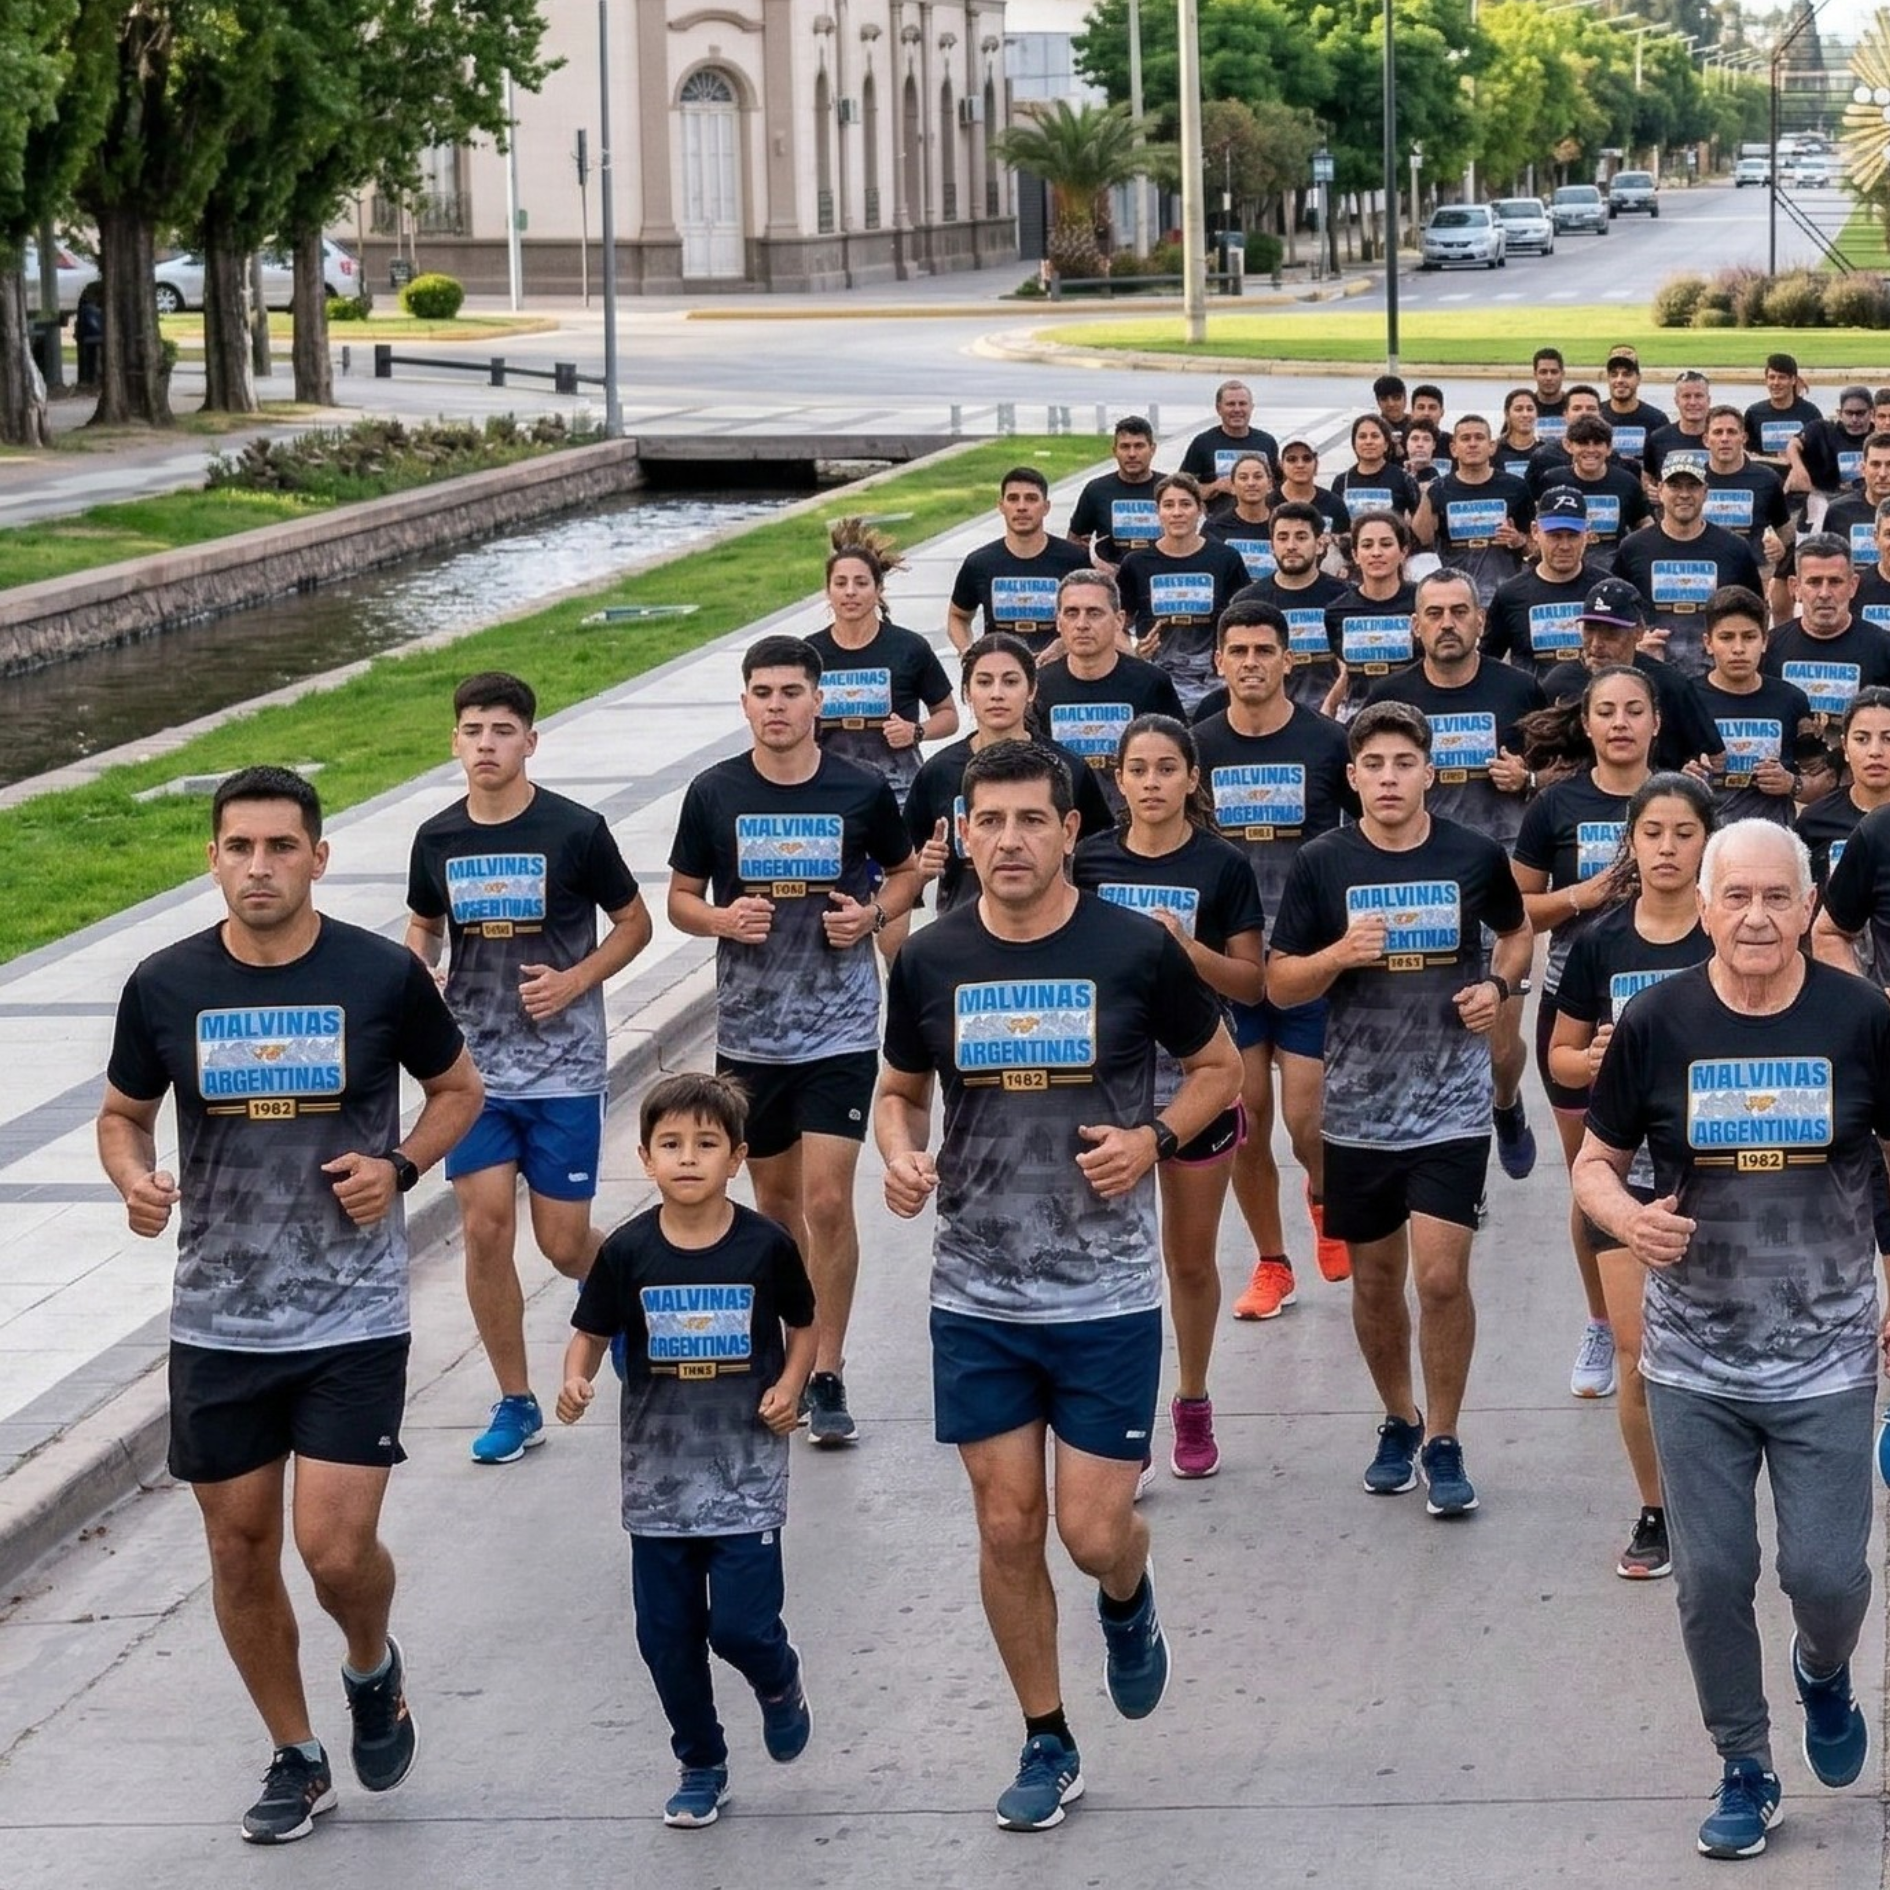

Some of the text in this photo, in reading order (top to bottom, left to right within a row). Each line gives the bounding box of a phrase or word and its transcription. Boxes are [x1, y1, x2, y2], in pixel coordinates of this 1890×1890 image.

[1214, 767, 1302, 786] MALVINAS
[739, 818, 841, 837] MALVINAS
[1349, 883, 1457, 909] MALVINAS
[1386, 928, 1457, 950] ENTINAS
[959, 984, 1091, 1012] MALVINAS
[202, 1009, 340, 1039] MALVINAS
[960, 1039, 1091, 1065] ARGENTINAS
[204, 1066, 341, 1093] ARGENTINAS
[1692, 1062, 1827, 1089] MALVINAS
[253, 1103, 291, 1115] 1982
[1694, 1119, 1827, 1143] ARGENTINAS
[1742, 1154, 1780, 1167] 1982
[643, 1289, 752, 1312] MALVINAS
